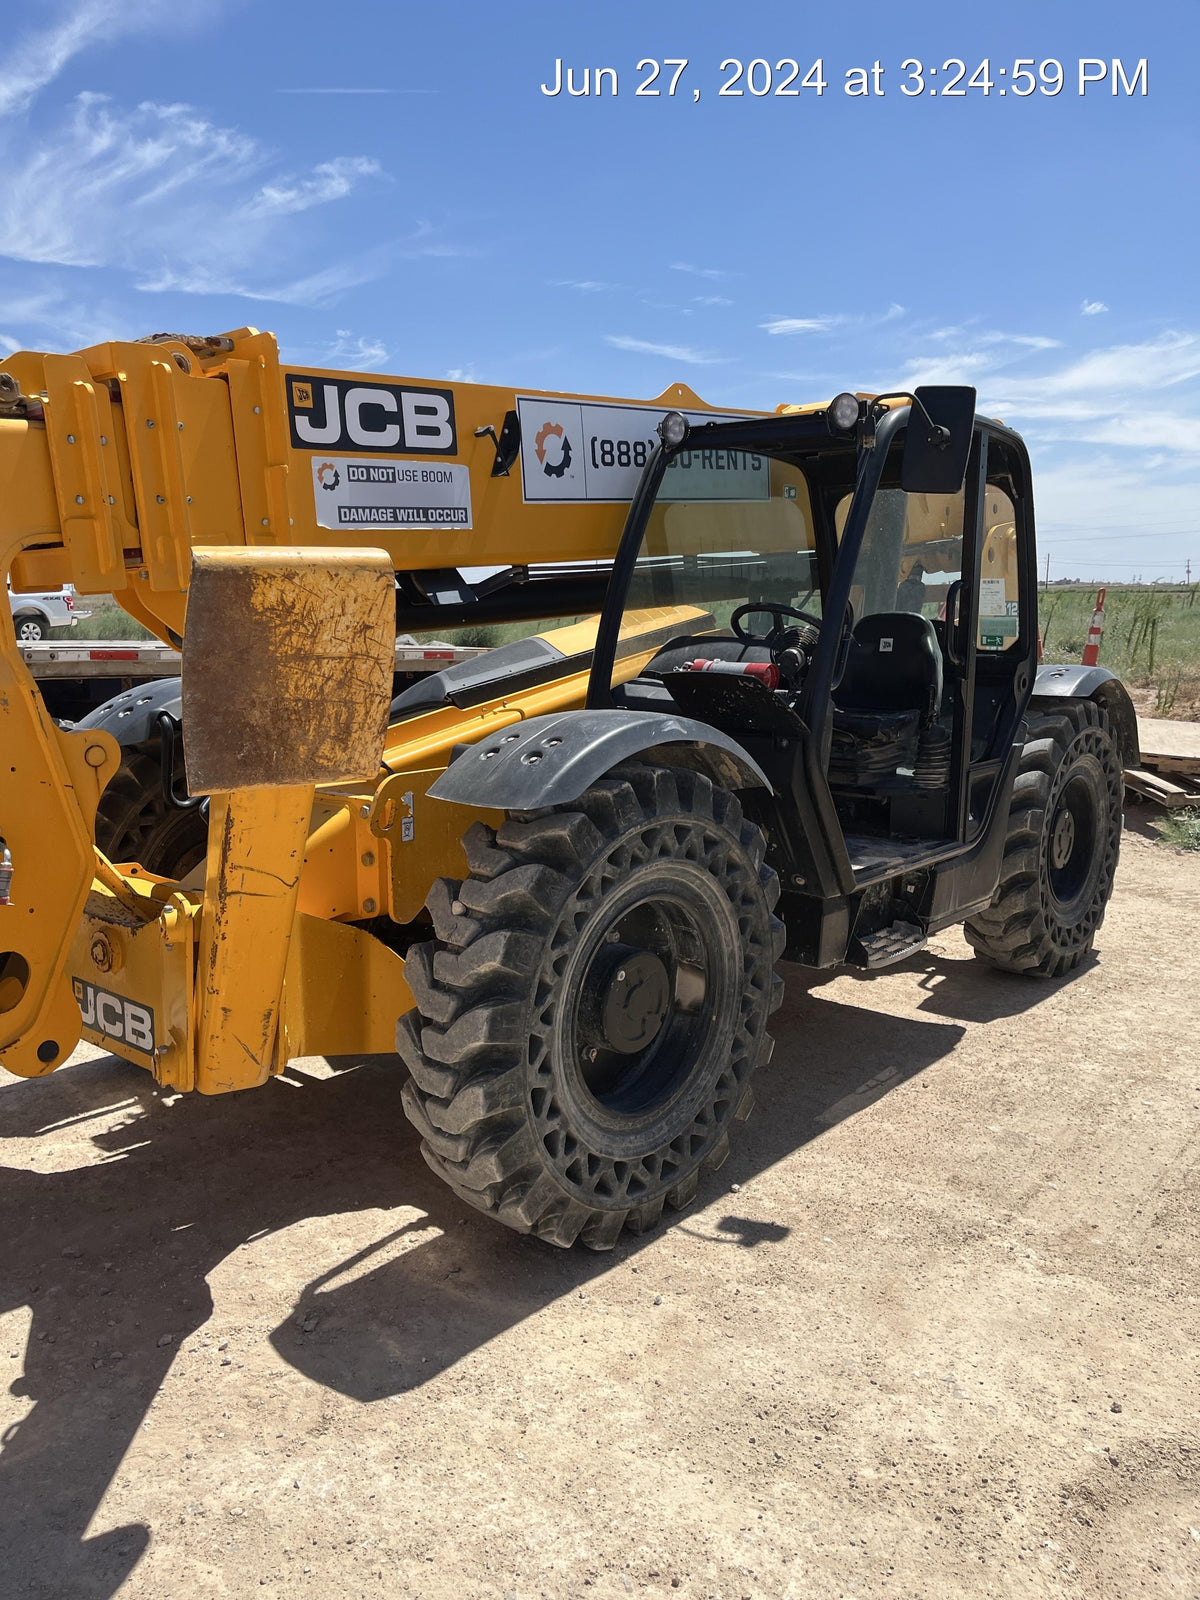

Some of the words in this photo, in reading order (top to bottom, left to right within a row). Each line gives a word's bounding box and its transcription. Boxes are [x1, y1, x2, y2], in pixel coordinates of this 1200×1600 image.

[294, 384, 453, 449] JCB
[349, 467, 367, 481] DO
[370, 467, 394, 482] NOT
[397, 469, 418, 483] USE
[421, 470, 453, 483] BOOM
[340, 507, 394, 521] DAMAGE
[396, 508, 426, 521] WILL
[427, 508, 466, 522] OCCUR
[78, 986, 153, 1051] JCB
